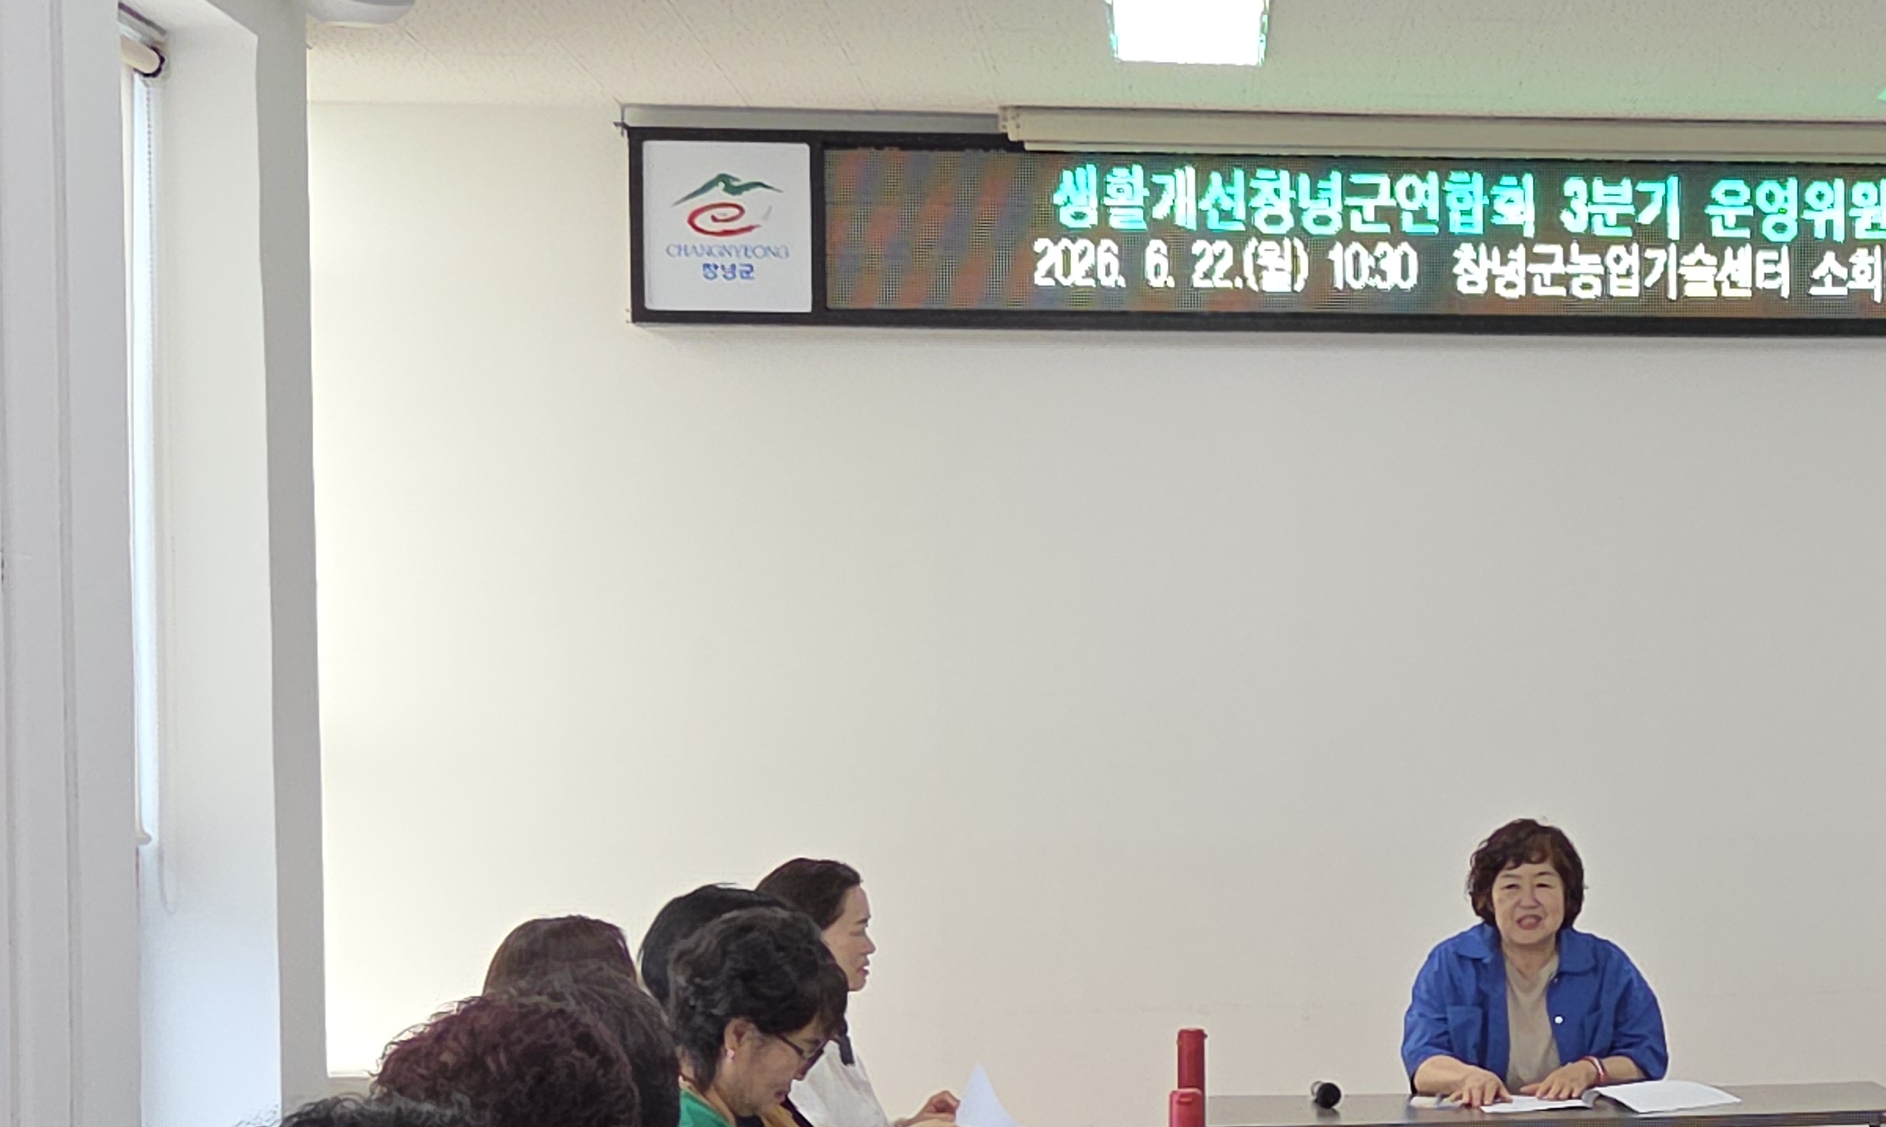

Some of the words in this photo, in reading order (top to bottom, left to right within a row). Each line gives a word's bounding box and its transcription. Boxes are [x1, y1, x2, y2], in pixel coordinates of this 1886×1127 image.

[1053, 163, 1534, 237] 생활개선창녕군연합회
[1560, 175, 1680, 241] 3분기
[665, 243, 790, 260] CHANGNYEONG
[702, 262, 755, 281] 창녕군
[1033, 238, 1126, 288] 2026.
[1145, 240, 1174, 288] 6.
[1191, 238, 1308, 292] 22.(월)
[1328, 241, 1418, 291] 10:30
[1452, 242, 1790, 300] 창녕군농업기술센터
